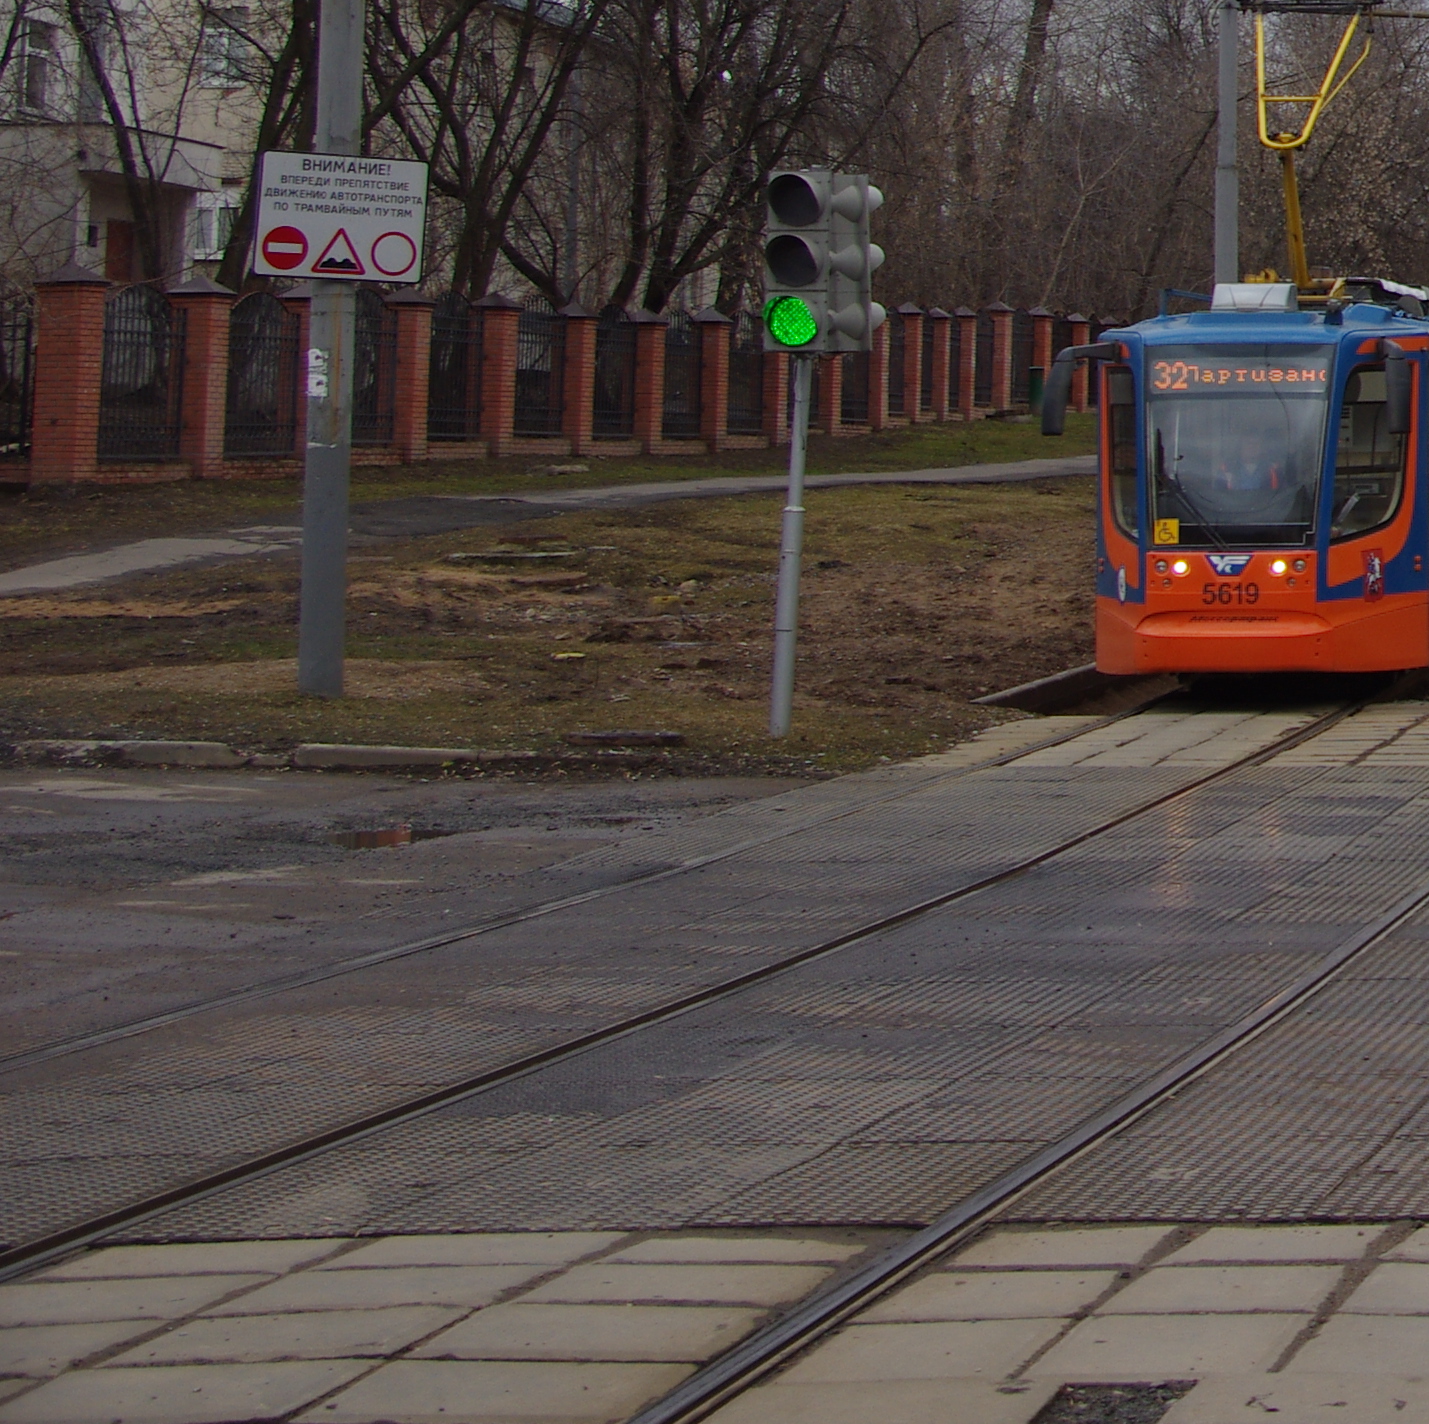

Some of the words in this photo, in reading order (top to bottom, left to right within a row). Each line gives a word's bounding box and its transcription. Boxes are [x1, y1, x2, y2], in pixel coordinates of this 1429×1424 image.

[302, 158, 392, 176] ВНИМАНИЕ!
[281, 175, 331, 187] ВПЕРЕДИ
[334, 178, 410, 191] ПРЕПЯТСТВИЕ
[264, 187, 328, 200] ДВИЖЕНИЮ
[330, 191, 424, 205] АВТОТРАНСПОРТА
[273, 201, 289, 212] ПО
[294, 202, 370, 216] ТРАМВАЙНЫМ
[375, 207, 414, 218] ПУТЯМ
[1153, 360, 1189, 390] 32
[1202, 582, 1260, 605] 5619
